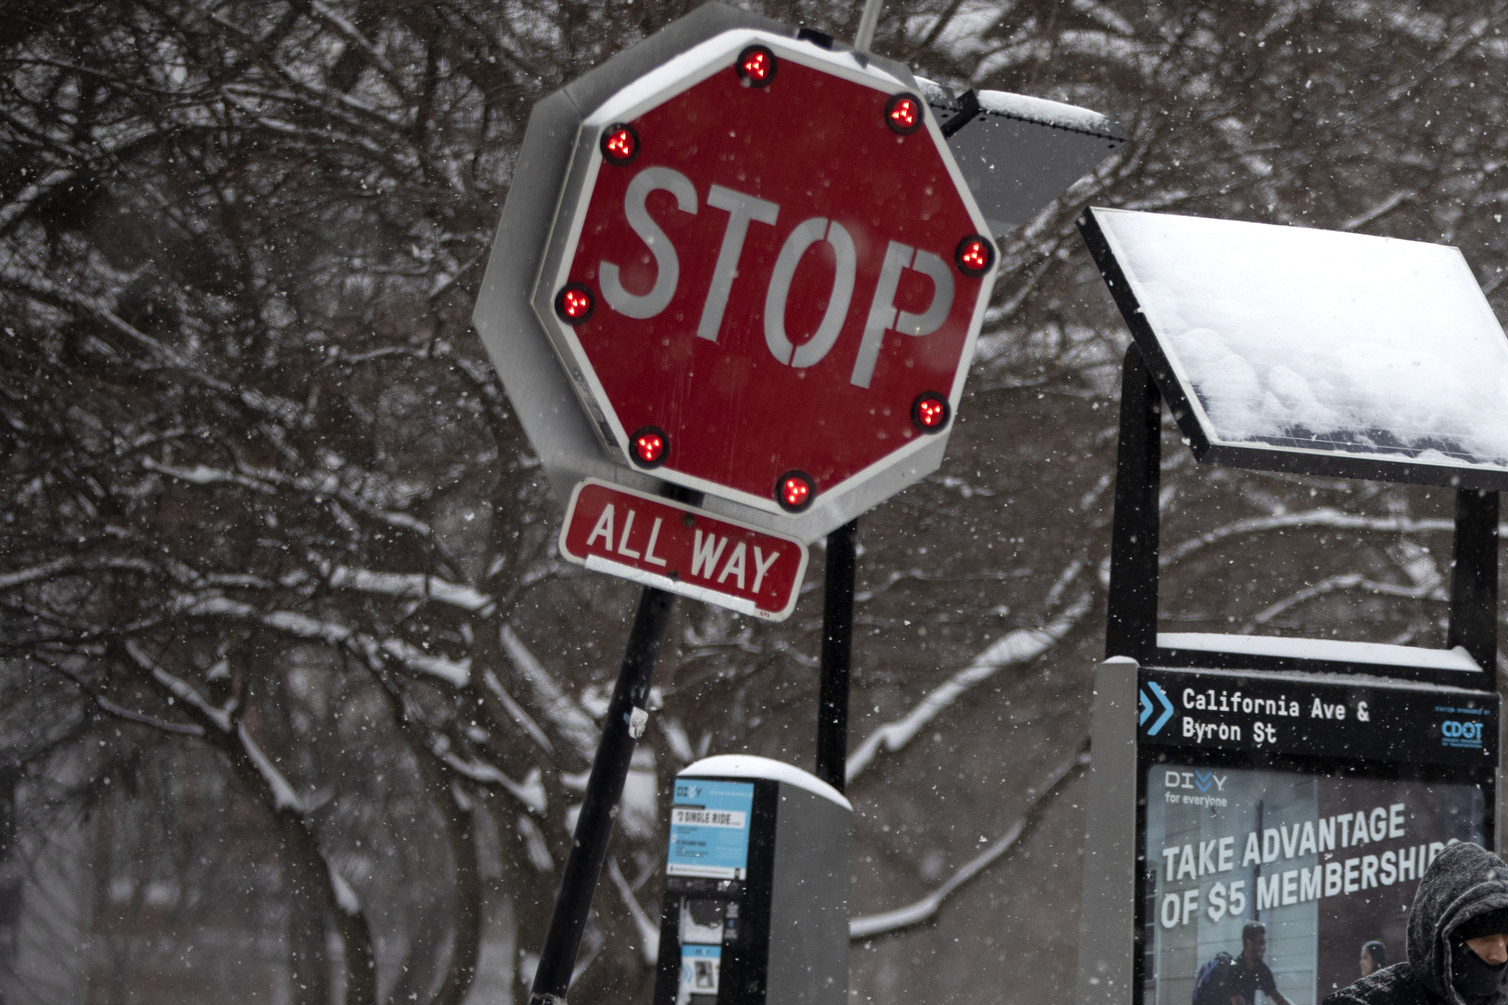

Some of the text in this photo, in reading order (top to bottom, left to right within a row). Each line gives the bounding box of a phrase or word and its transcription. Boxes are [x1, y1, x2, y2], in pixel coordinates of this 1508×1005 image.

[599, 166, 955, 389] STOP
[587, 504, 781, 594] ALL WAY
[1183, 688, 1370, 722] California Ave &
[1183, 717, 1277, 743] Byron St
[1441, 720, 1483, 739] CDOT
[1165, 791, 1228, 808] for everyone
[712, 813, 731, 825] RIDE
[1162, 803, 1405, 882] TAKE ADVANTAGE
[1160, 838, 1459, 928] OF $5 MEMBERSHIP
